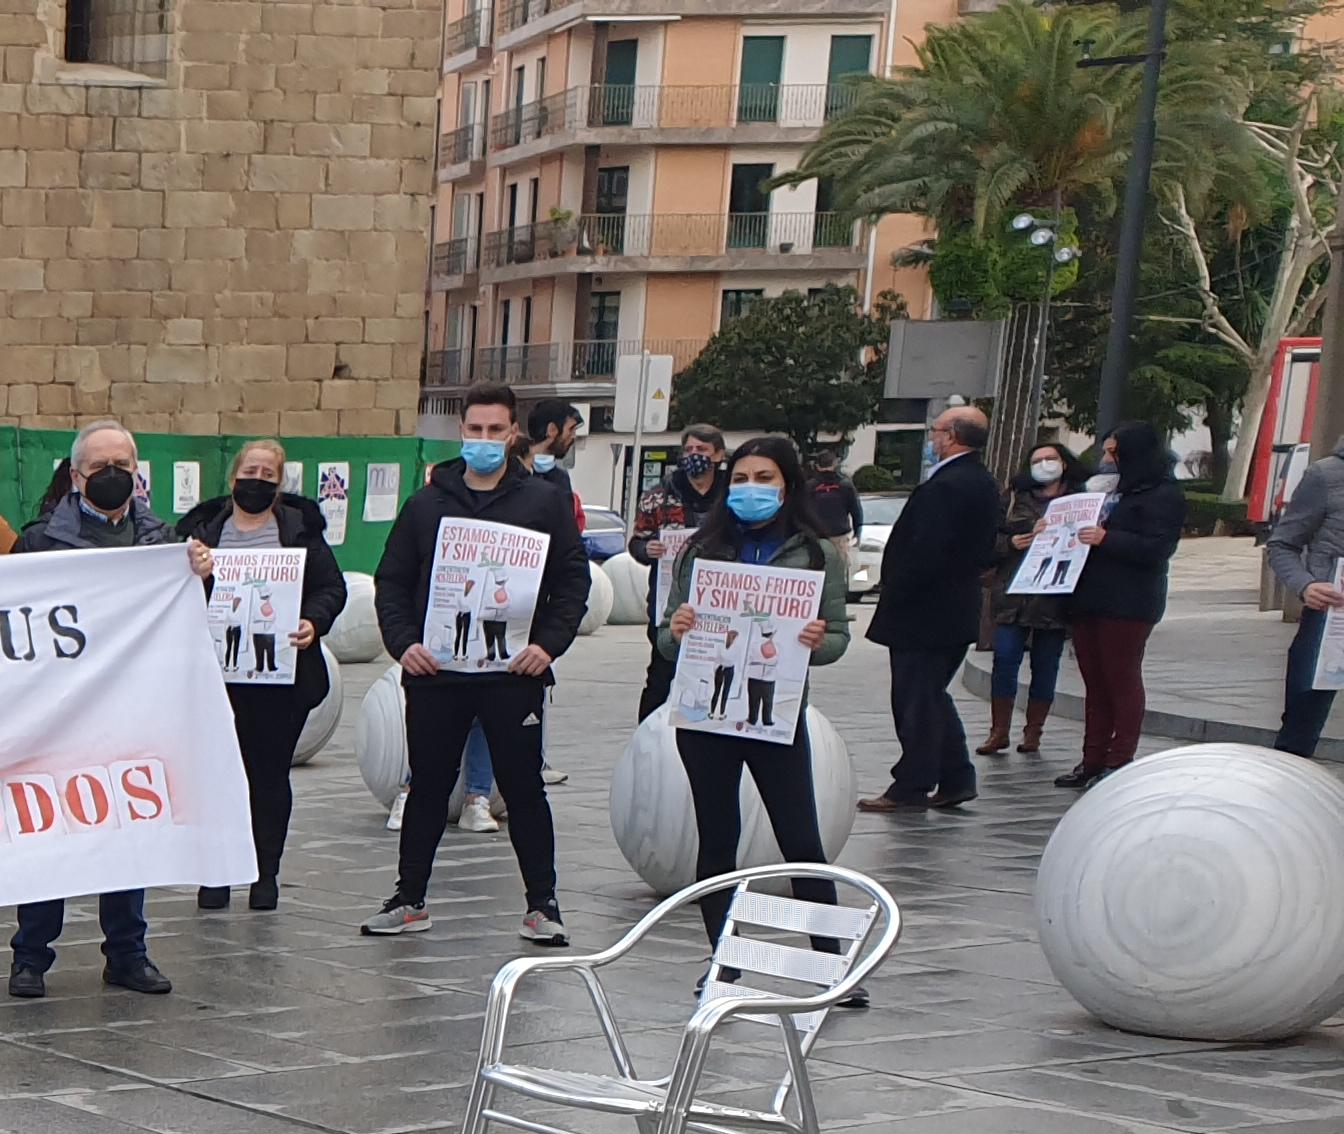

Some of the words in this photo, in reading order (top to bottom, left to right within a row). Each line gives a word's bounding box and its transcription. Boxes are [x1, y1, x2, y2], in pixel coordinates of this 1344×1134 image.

[442, 525, 499, 545] ESTAMOS
[500, 531, 544, 551] FRITOS
[212, 554, 258, 567] STAMOS
[261, 554, 300, 566] FRITOS
[441, 542, 451, 560] Y
[452, 542, 478, 562] SIN
[480, 545, 542, 569] FUTURO
[217, 568, 241, 582] SIN
[244, 566, 299, 582] FUTURO
[696, 568, 762, 592] ESTAMOS
[764, 575, 817, 598] FRITOS
[695, 587, 706, 606] Y
[710, 588, 739, 611] SIN
[742, 592, 813, 620] FUTURO
